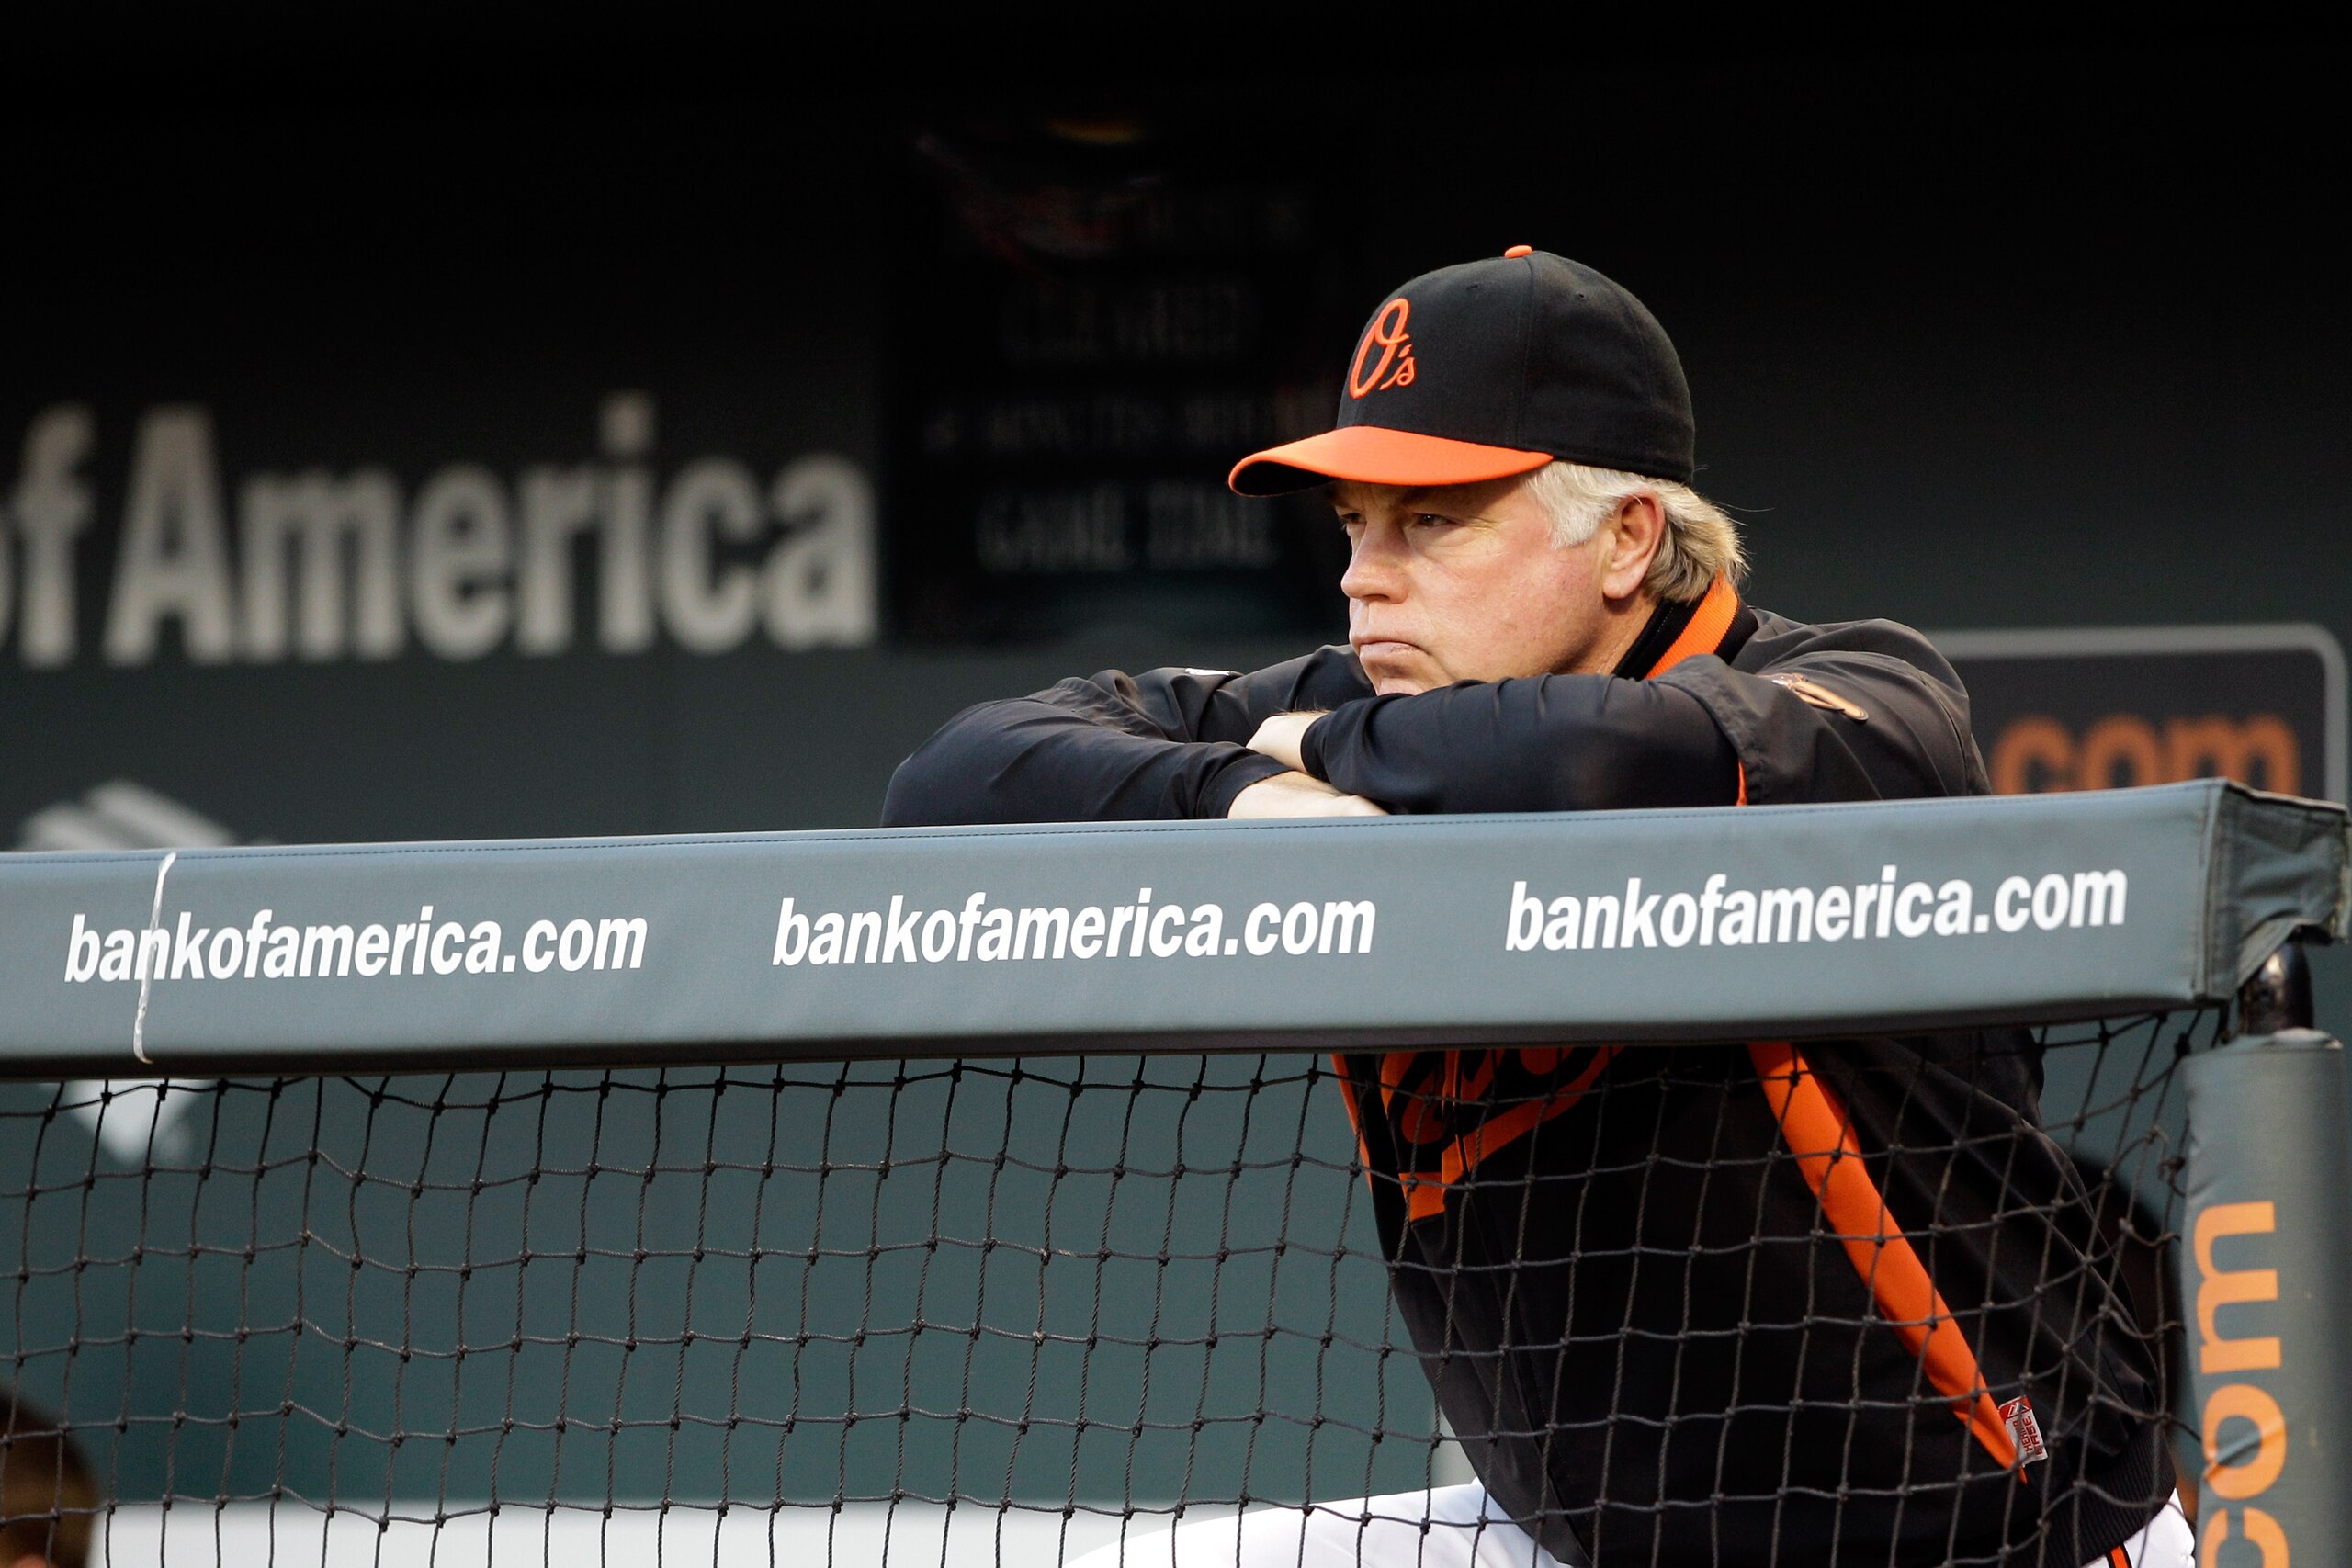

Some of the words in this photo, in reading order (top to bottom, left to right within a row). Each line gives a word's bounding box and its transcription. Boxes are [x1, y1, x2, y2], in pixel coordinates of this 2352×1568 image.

[1349, 296, 1418, 400] O's
[0, 402, 96, 671] f
[105, 388, 878, 667] America
[63, 906, 648, 983] bankofamerica.com
[772, 887, 1376, 966] bankofamerica.com
[1505, 865, 2129, 953] bankofamerica.com
